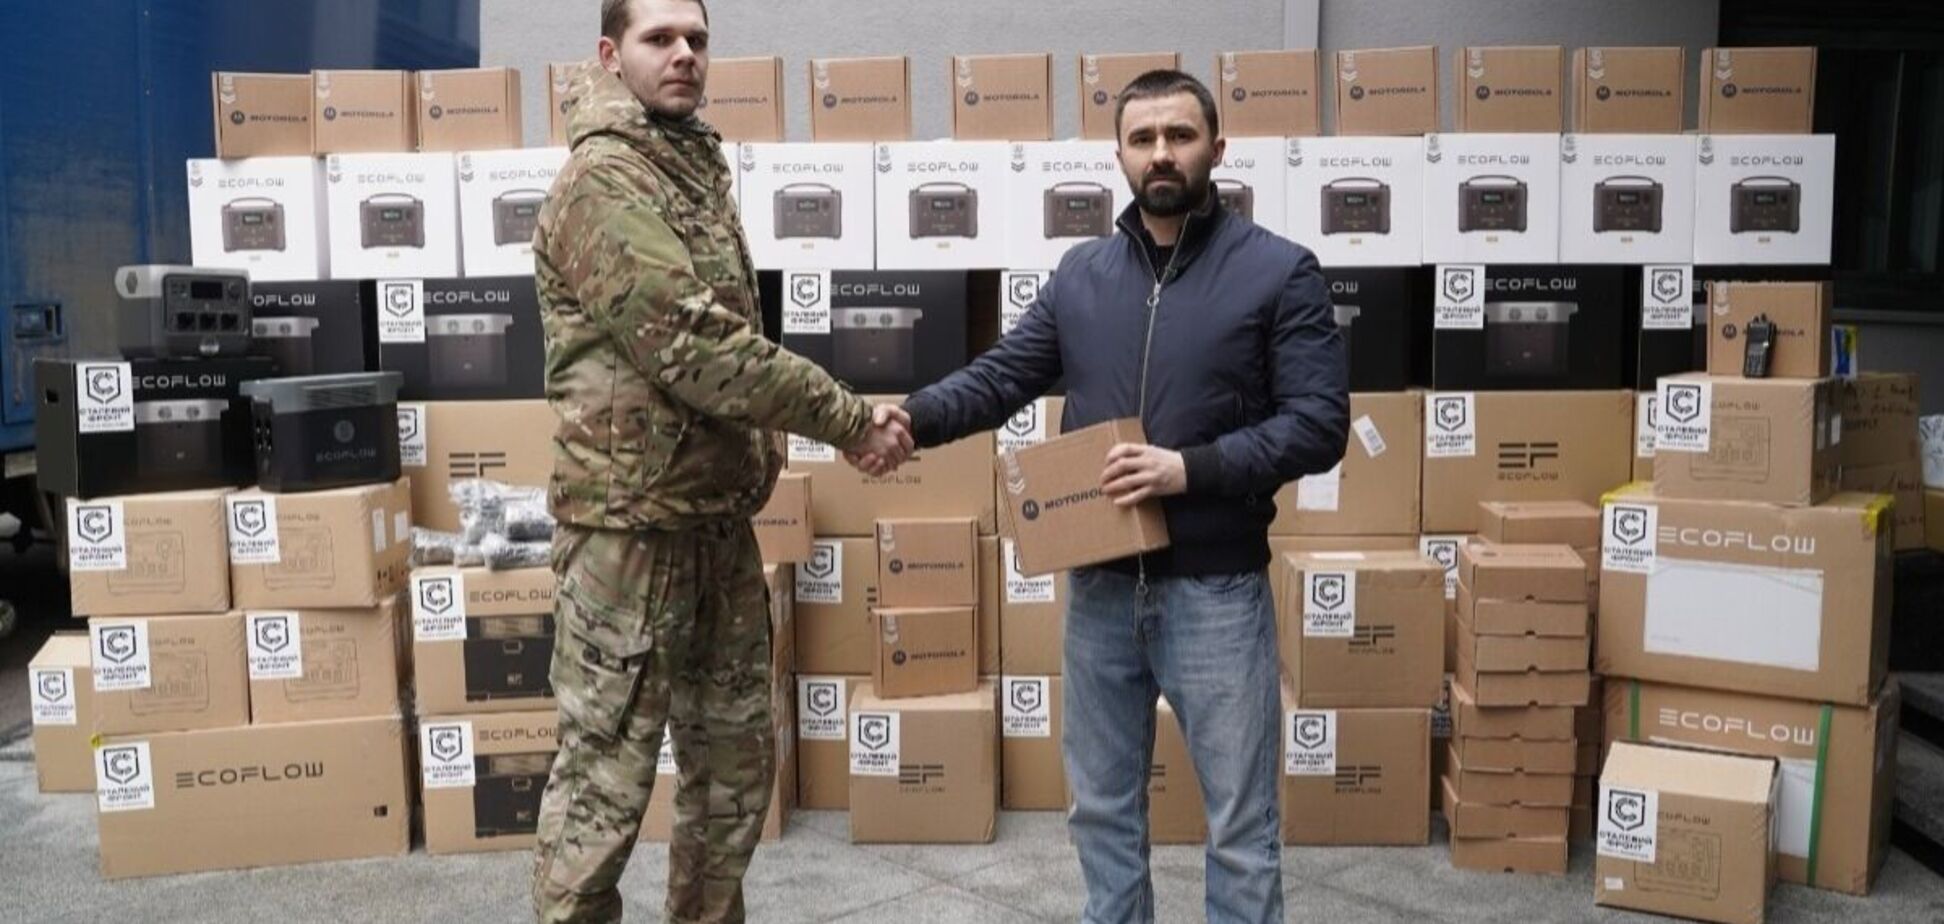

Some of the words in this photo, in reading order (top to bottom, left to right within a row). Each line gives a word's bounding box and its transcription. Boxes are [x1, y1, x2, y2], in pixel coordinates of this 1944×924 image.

[1250, 89, 1308, 97] MOTOROLA
[1369, 86, 1426, 95] MOTOROLA
[841, 95, 897, 104] MOTOROLA
[1319, 157, 1393, 166] ECOFLOW
[1457, 155, 1530, 165] ECOFLOW
[1593, 155, 1667, 165] ECOFLOW
[1730, 156, 1803, 166] ECOFLOW
[772, 163, 844, 173] ECOFLOW
[907, 161, 979, 172] ECOFLOW
[1042, 161, 1114, 172] ECOFLOW
[358, 173, 426, 183] ECOFLOW
[489, 168, 557, 180] ECOFLOW
[218, 178, 284, 188] ECOFLOW
[254, 293, 315, 306] OFLOW
[1712, 401, 1760, 410] COFLOW
[315, 448, 377, 462] ECOFLOW
[1044, 487, 1105, 510] MOTOROL
[124, 518, 172, 527] COFLOW
[1658, 526, 1816, 554] ECOFLOW
[908, 562, 964, 570] MOTOROLA
[470, 589, 552, 603] ECOFLOW
[910, 650, 966, 660] MOTOROLA
[1659, 707, 1815, 746] ECOFLOW
[176, 762, 324, 789] ECOFLOW
[1658, 811, 1711, 825] COFLOW
